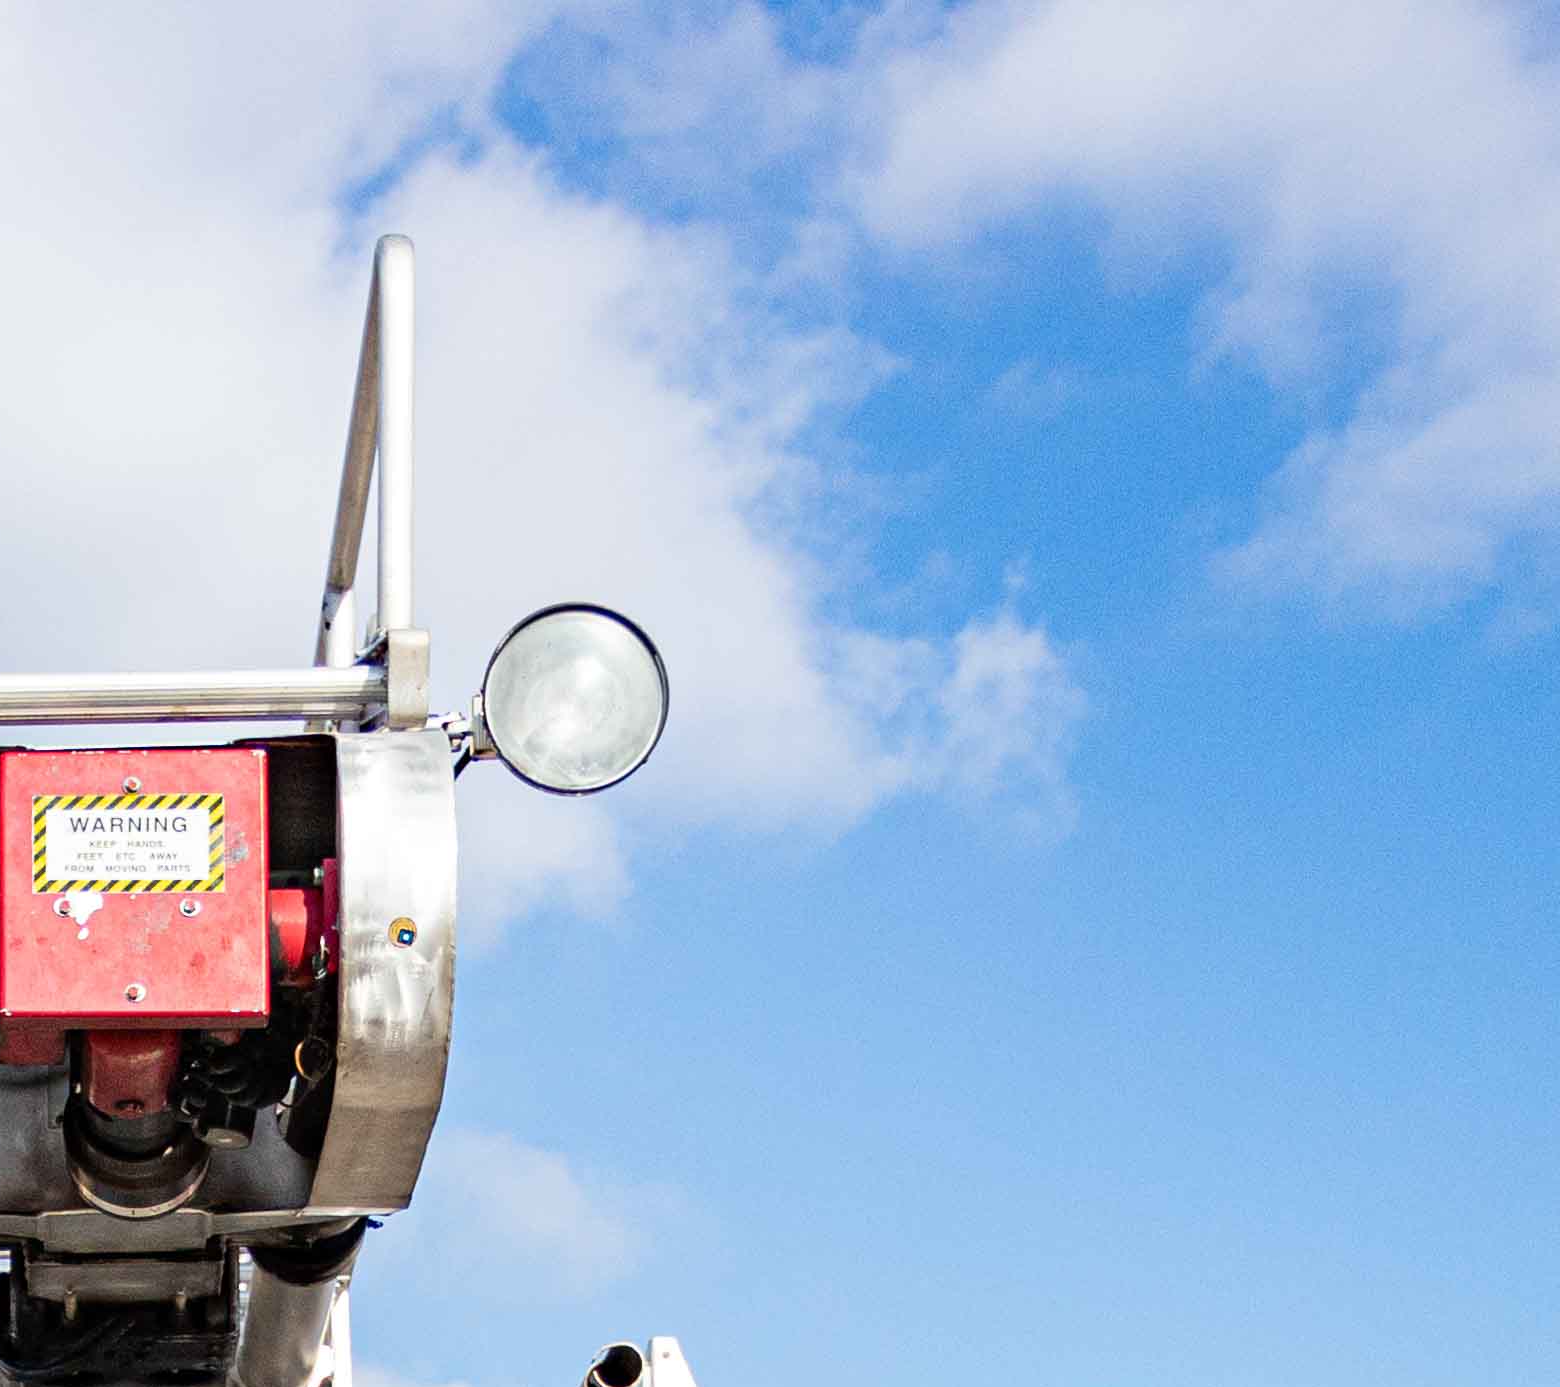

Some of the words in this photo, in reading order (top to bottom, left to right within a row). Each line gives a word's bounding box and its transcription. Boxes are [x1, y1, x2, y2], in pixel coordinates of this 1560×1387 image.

[70, 816, 187, 833] WARNING
[89, 840, 117, 849] KEEP
[149, 852, 177, 861] AWAY
[64, 864, 94, 873] FROM
[105, 864, 147, 873] MOVING
[157, 864, 192, 873] PARTS
